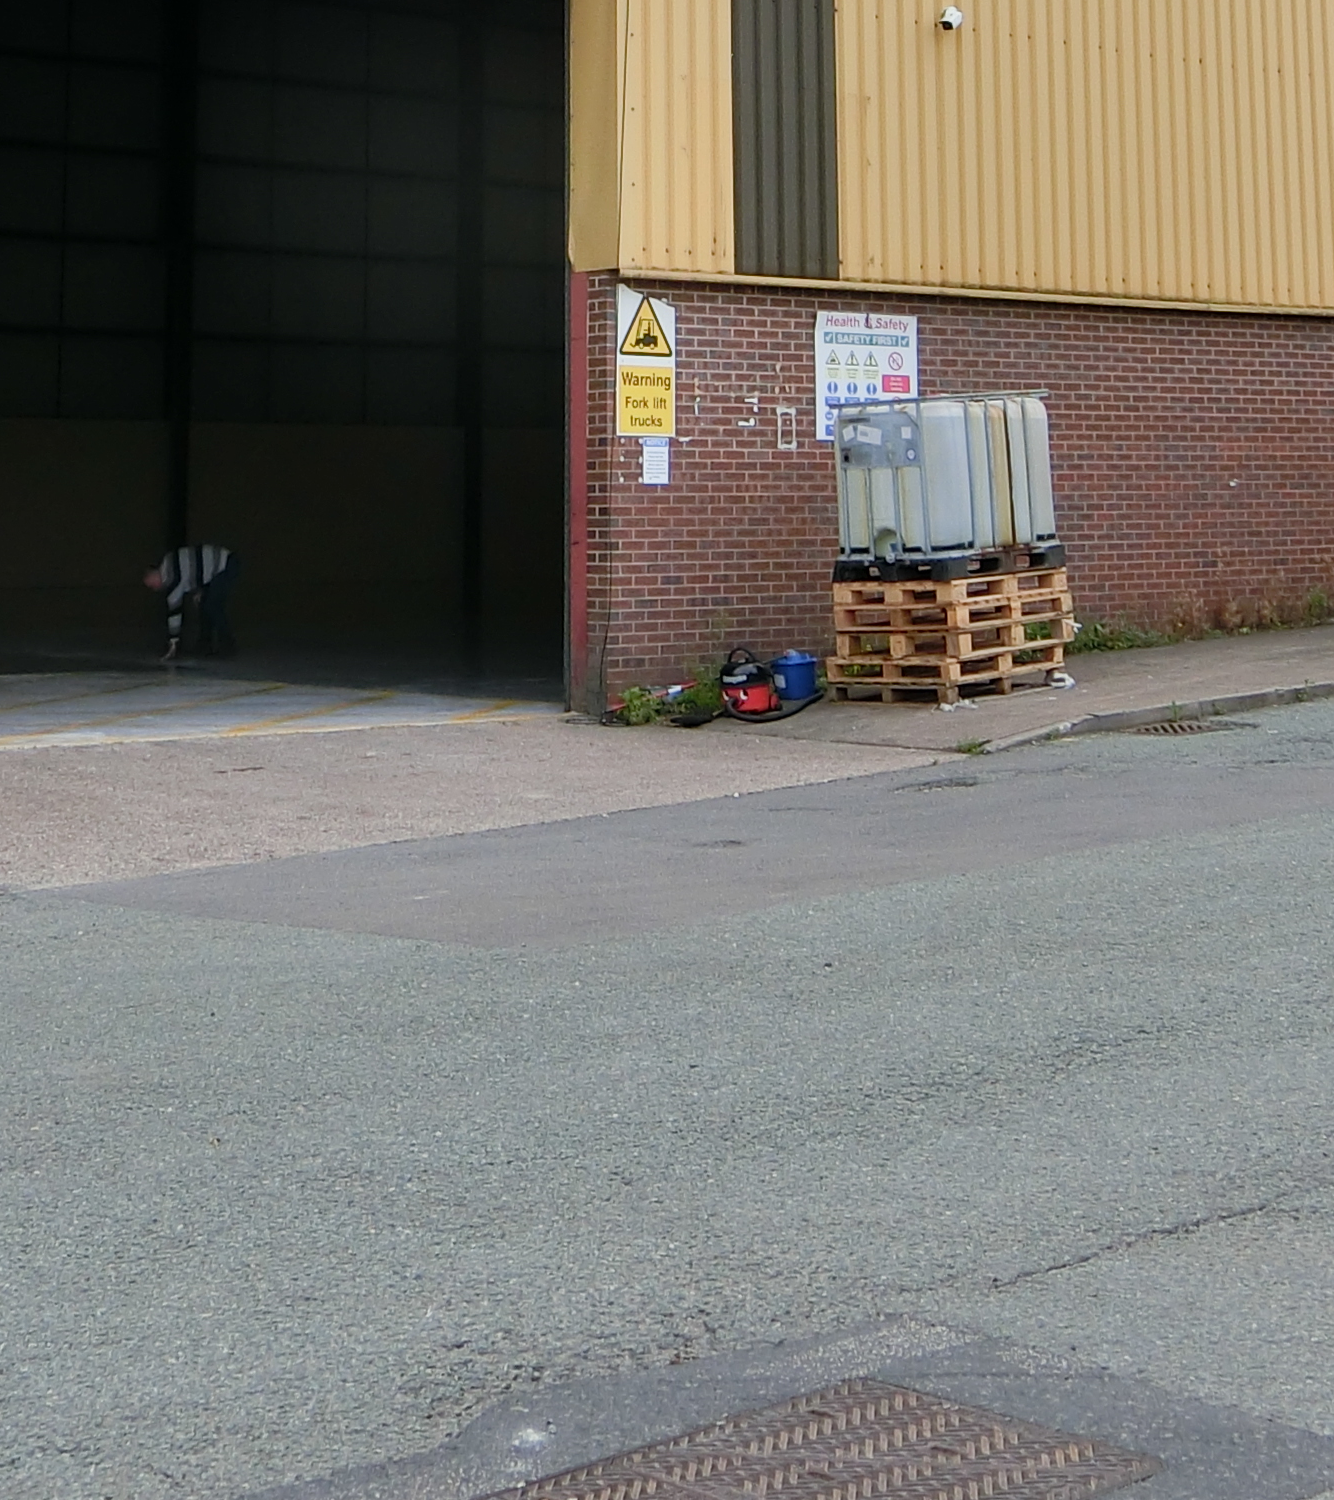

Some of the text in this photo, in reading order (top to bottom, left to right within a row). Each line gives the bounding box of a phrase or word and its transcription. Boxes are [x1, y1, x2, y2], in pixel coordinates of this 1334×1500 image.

[825, 315, 860, 328] Health
[874, 318, 909, 333] Safety
[836, 333, 898, 346] SAFETY FIRST
[621, 371, 672, 391] Warning
[625, 396, 668, 410] Fork lift
[630, 414, 663, 428] trucks
